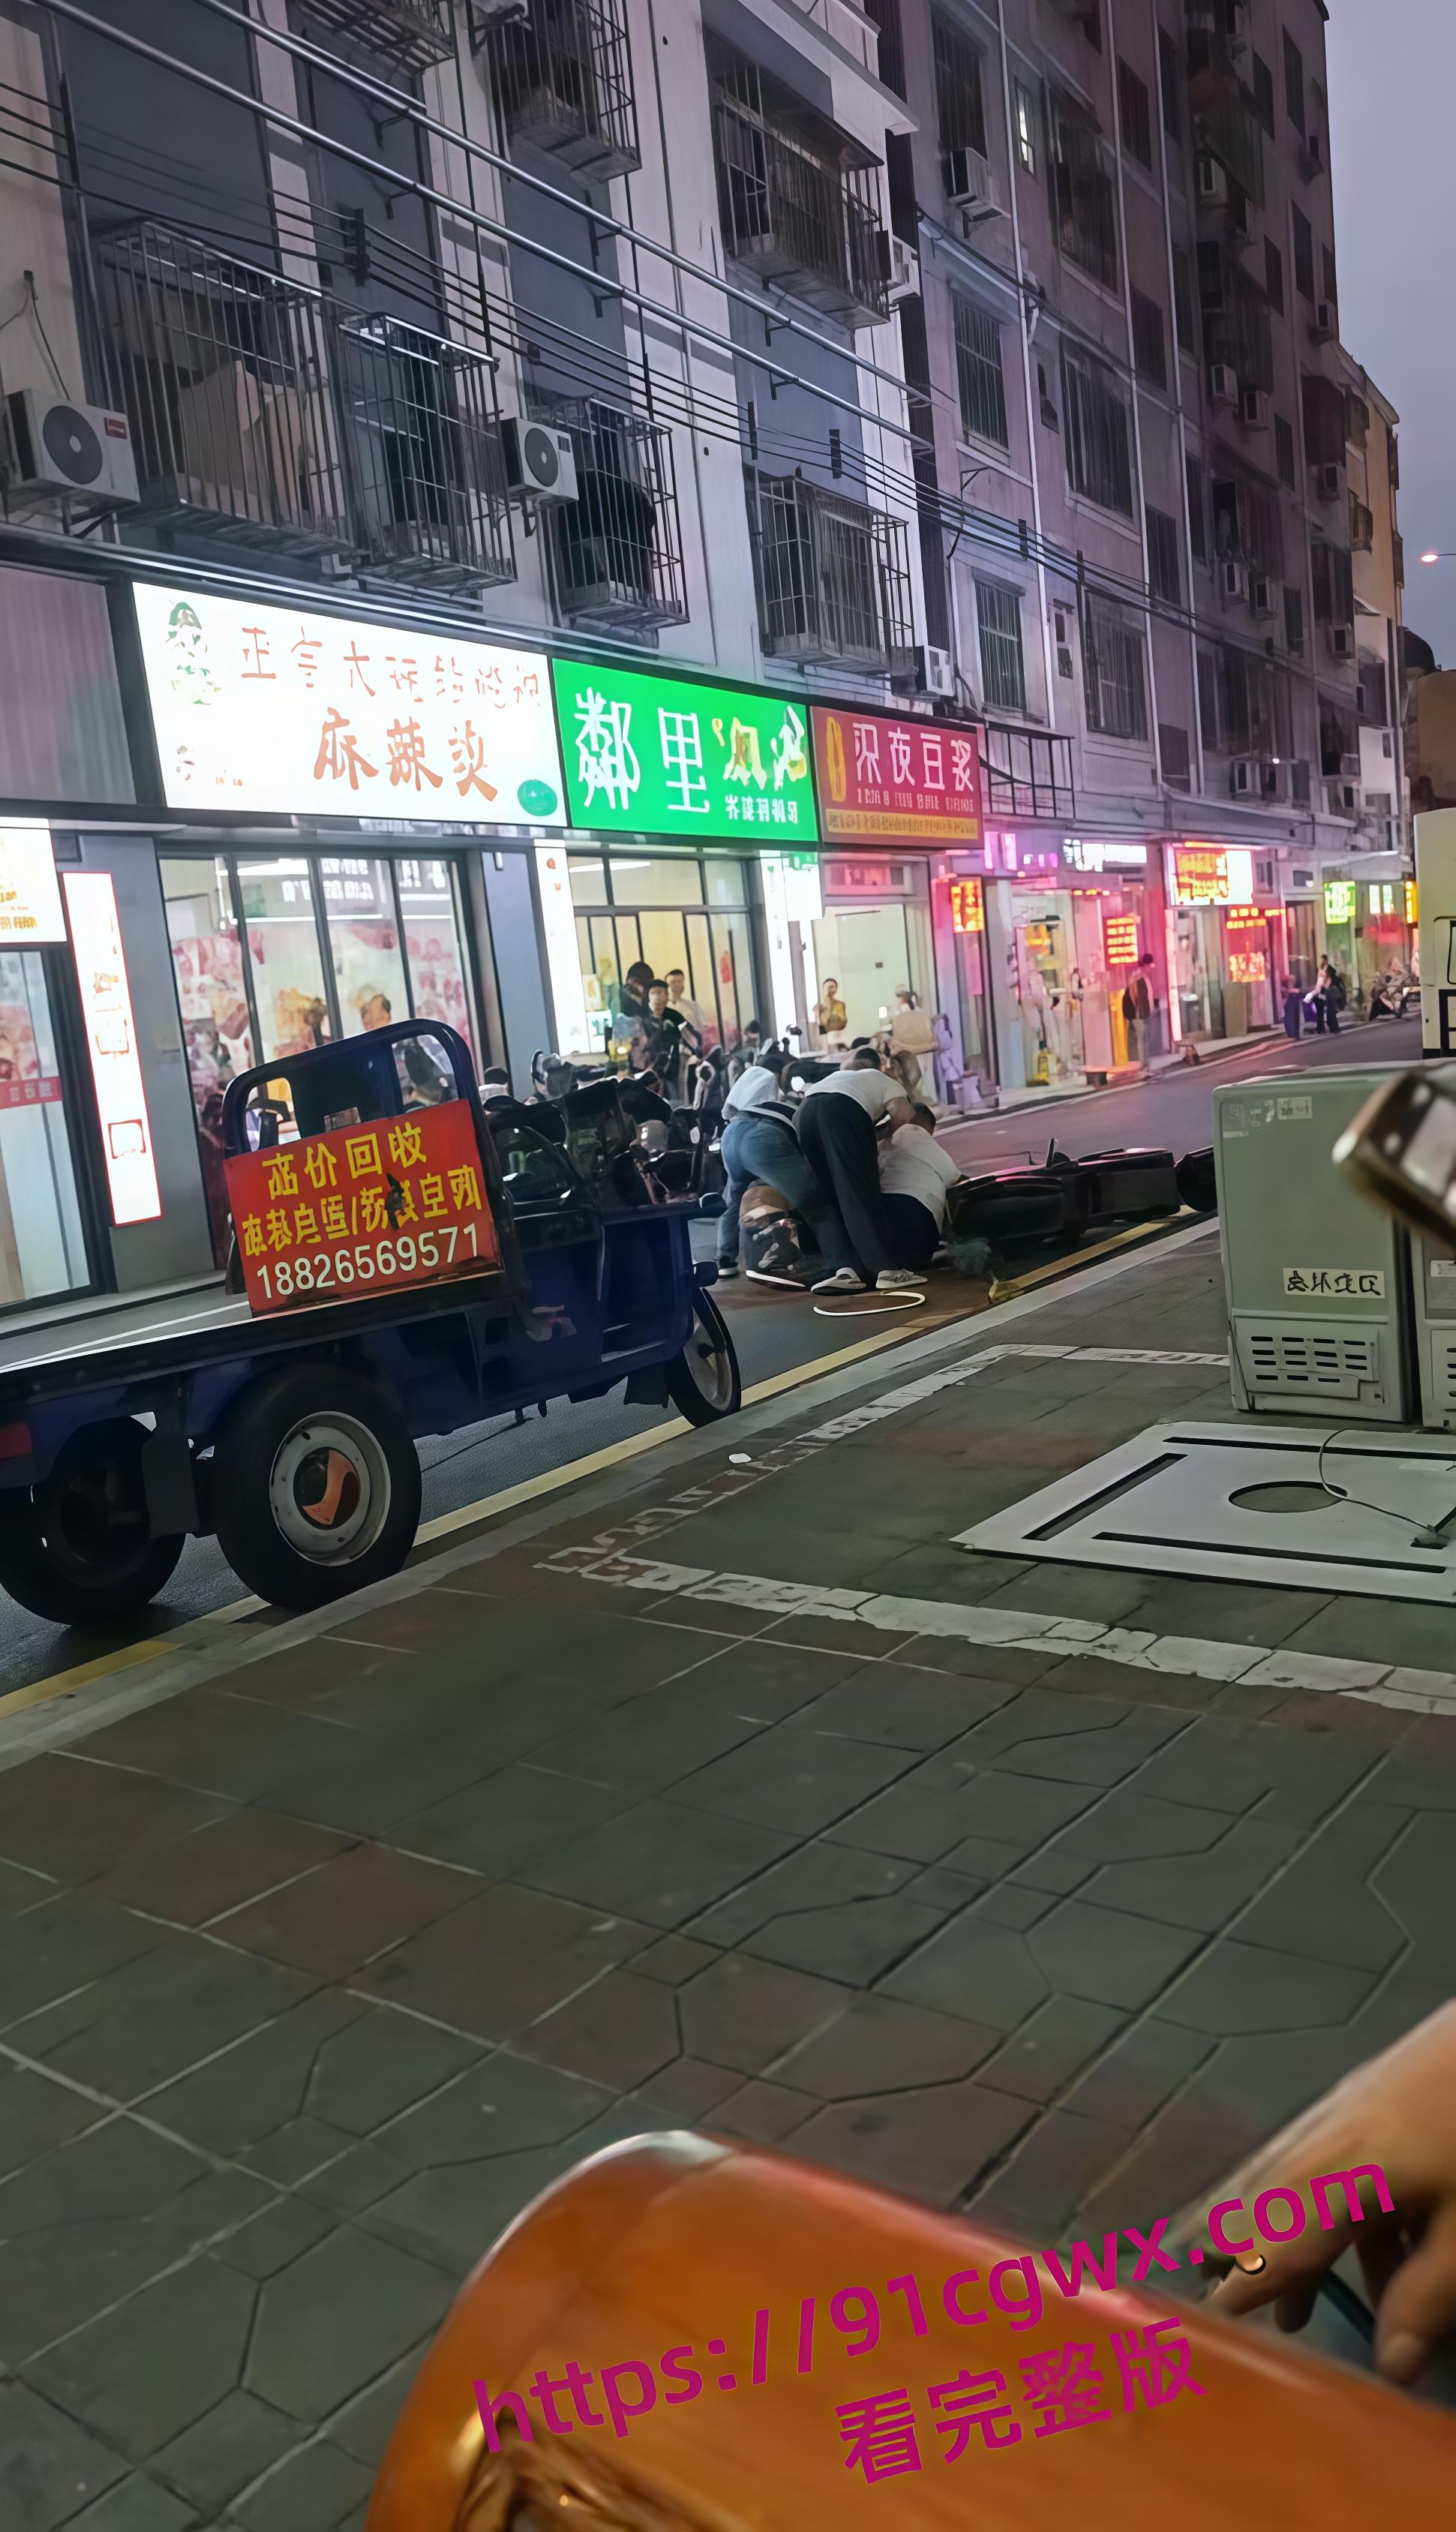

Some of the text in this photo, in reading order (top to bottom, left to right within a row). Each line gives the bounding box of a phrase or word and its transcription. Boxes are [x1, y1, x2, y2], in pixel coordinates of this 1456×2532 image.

[262, 1121, 427, 1200] 高价回收
[256, 1222, 478, 1299] 18826569571
